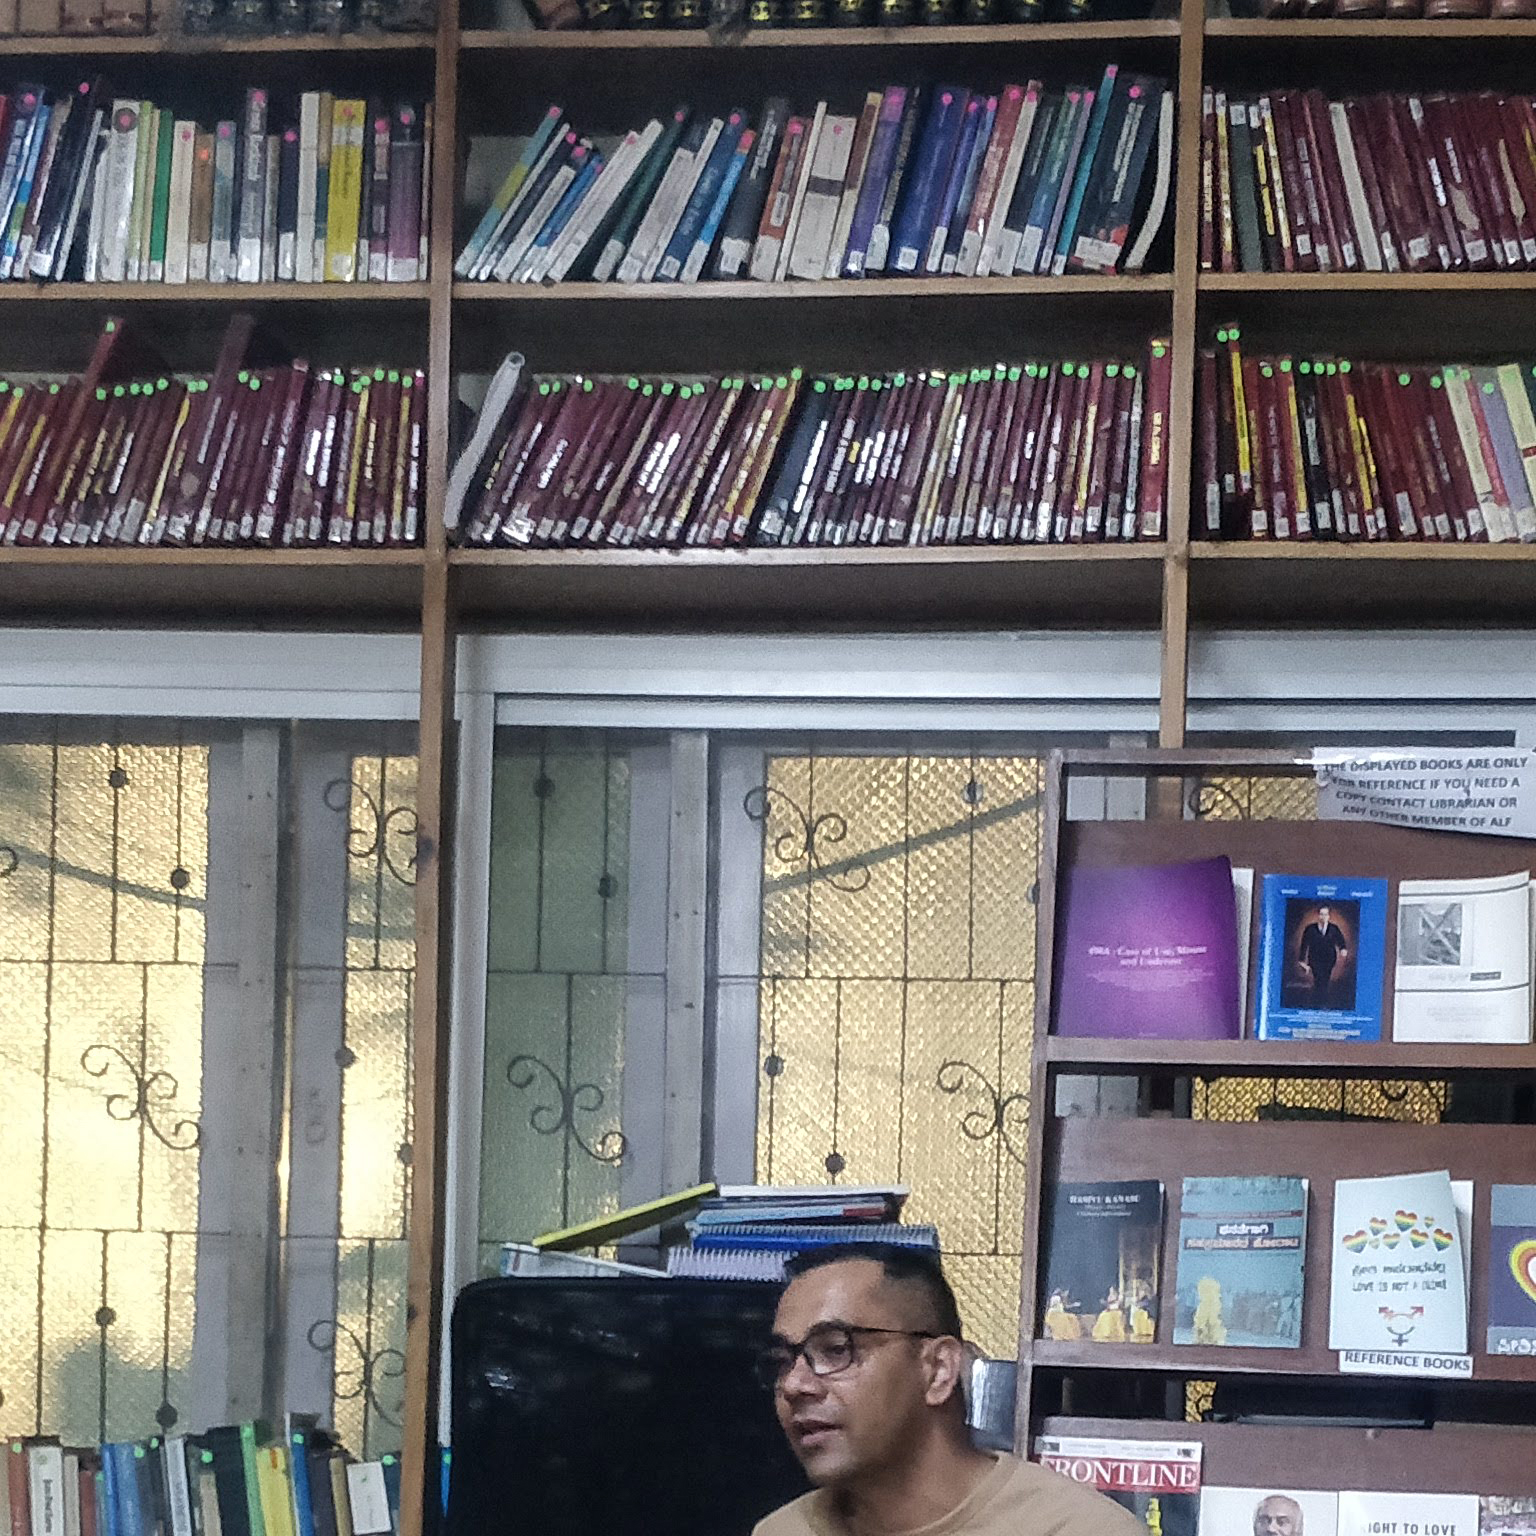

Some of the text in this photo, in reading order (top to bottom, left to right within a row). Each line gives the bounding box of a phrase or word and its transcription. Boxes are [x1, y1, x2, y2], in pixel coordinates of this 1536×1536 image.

[1350, 759, 1416, 771] DISPLAYED
[1420, 758, 1463, 770] BOOKS
[1466, 758, 1490, 769] ARE
[1493, 757, 1529, 768] ONLY
[1359, 778, 1426, 790] REFERENCE
[1430, 778, 1440, 789] IF
[1444, 777, 1470, 790] YOU
[1474, 777, 1508, 788] NEED
[1510, 777, 1520, 788] A
[1369, 795, 1426, 808] CONTACT
[1429, 796, 1496, 808] LIBRARIAN
[1498, 797, 1518, 808] OR
[1411, 814, 1467, 826] MEMBER
[1470, 816, 1486, 827] OF
[1489, 817, 1512, 827] ALF
[1344, 1352, 1470, 1372] REFERENCE BOOKS
[1366, 1522, 1457, 1536] IGHT TO LOVE
